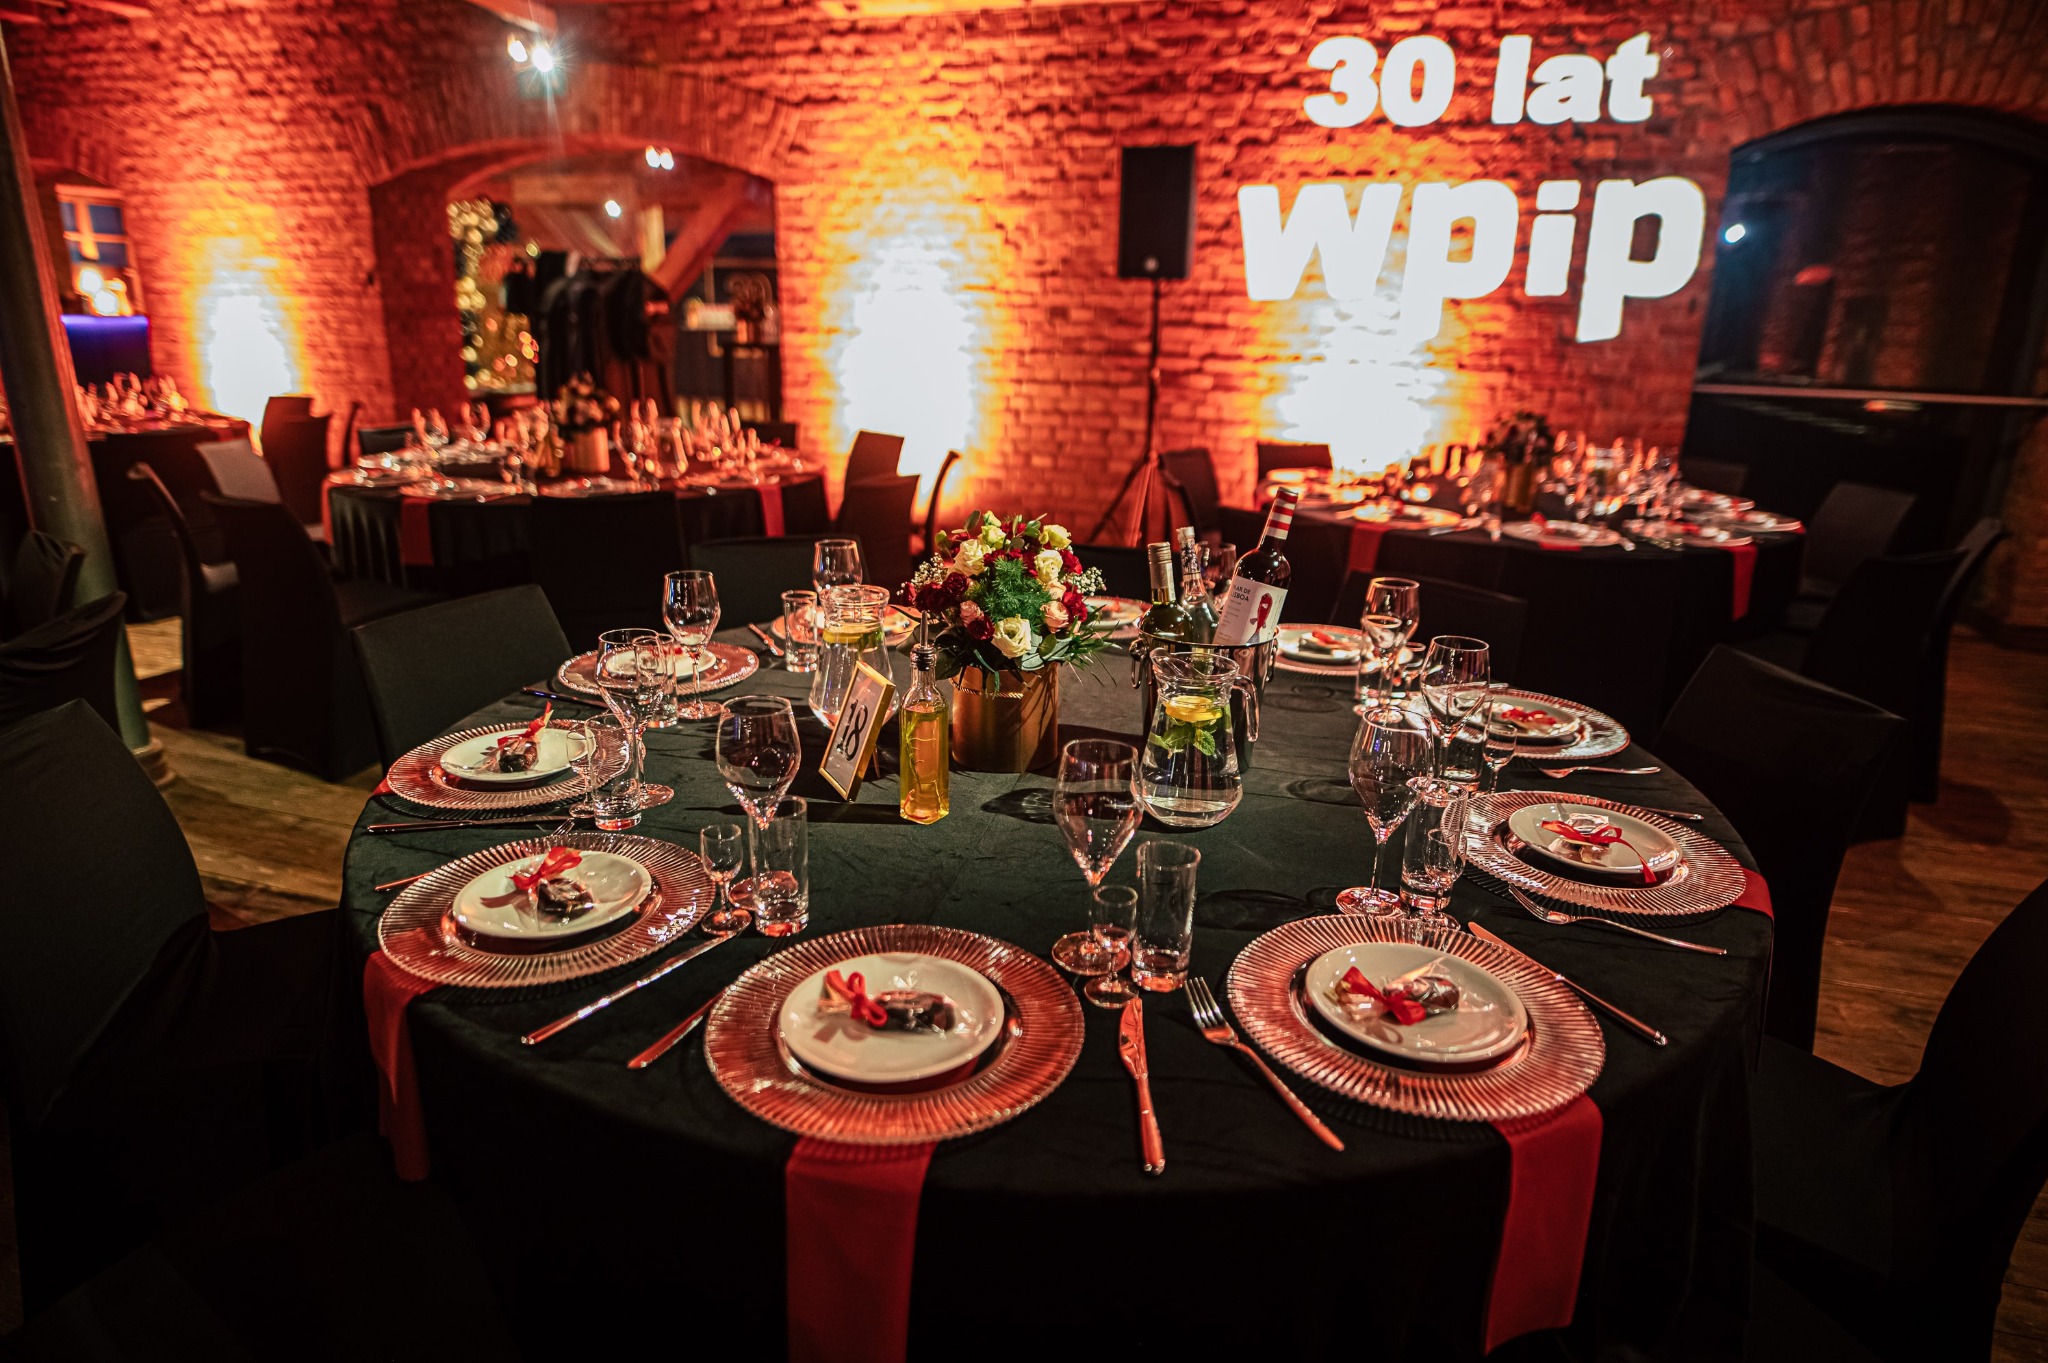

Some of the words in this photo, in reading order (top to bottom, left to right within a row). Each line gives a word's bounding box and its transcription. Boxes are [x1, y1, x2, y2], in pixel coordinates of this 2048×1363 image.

[1303, 35, 1456, 128] 30
[1491, 32, 1661, 124] lat
[1238, 177, 1706, 343] wpip
[1231, 591, 1250, 601] ISBOA
[836, 699, 868, 761] 18
